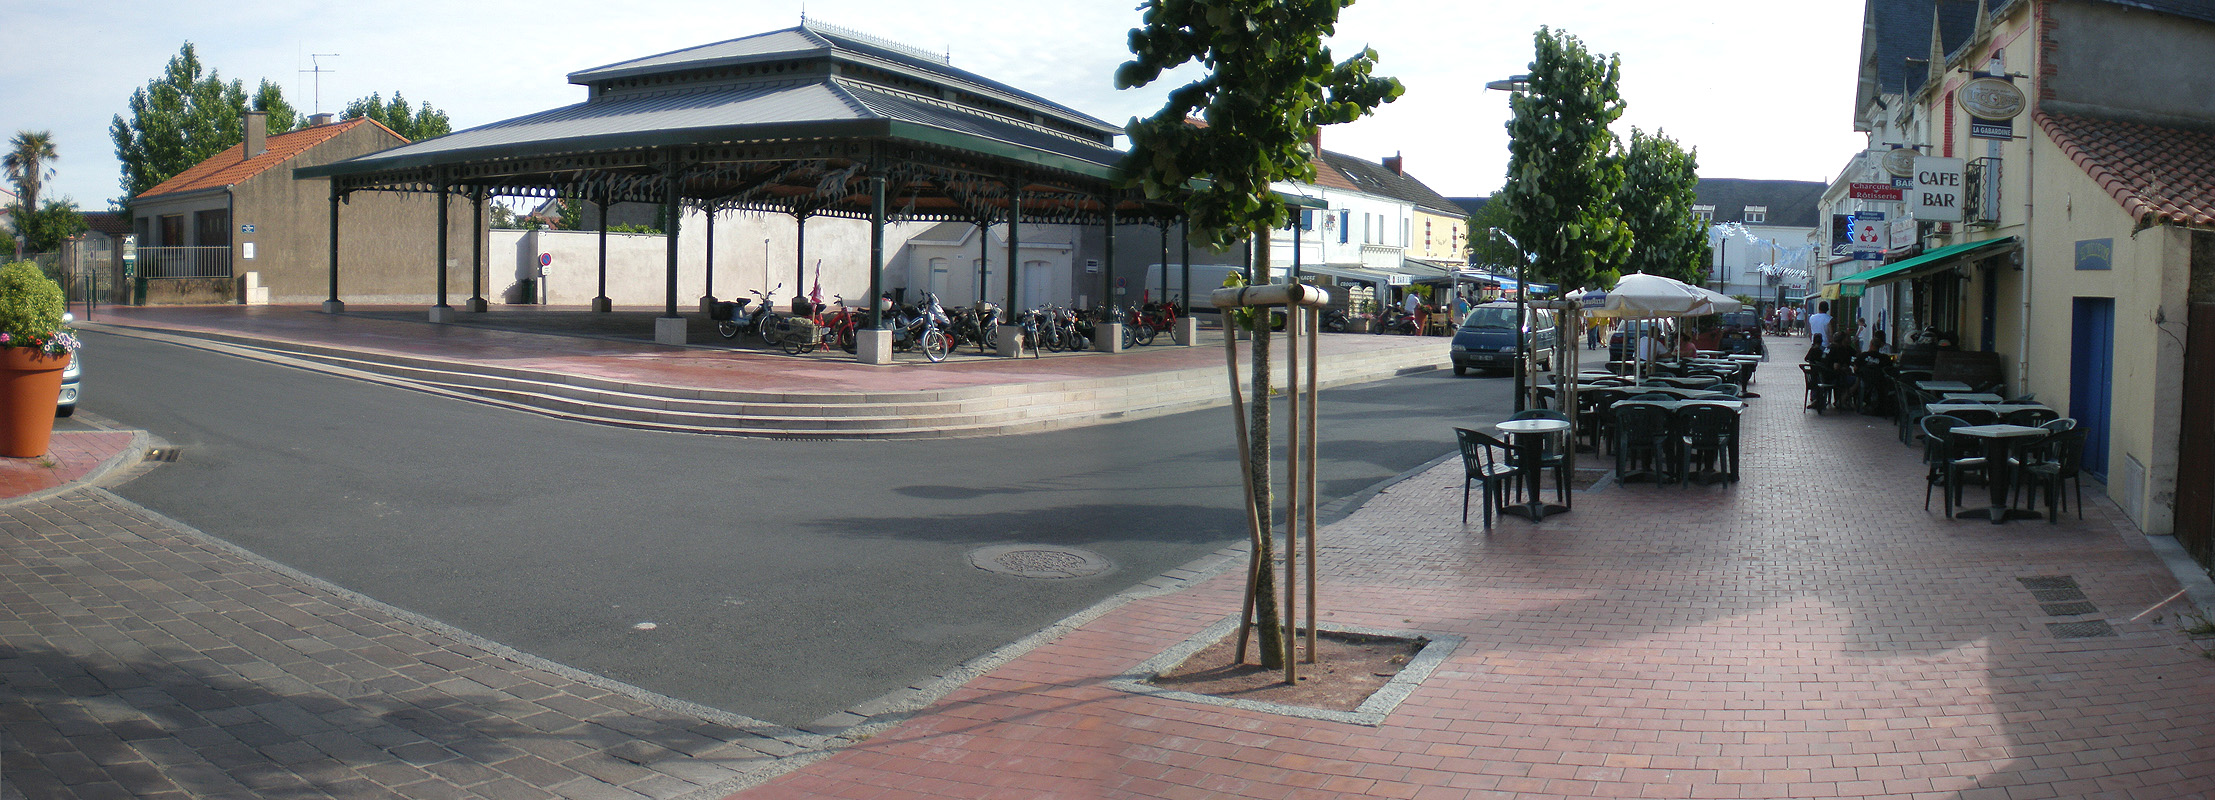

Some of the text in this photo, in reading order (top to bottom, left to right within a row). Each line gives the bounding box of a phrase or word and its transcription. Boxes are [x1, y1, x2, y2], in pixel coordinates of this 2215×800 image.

[1980, 127, 2011, 136] GABARDINE
[1919, 171, 1960, 186] CAFE
[1852, 182, 1895, 190] Charcute
[1896, 179, 1914, 187] BAR
[1856, 191, 1897, 199] Rôtisserie
[1922, 192, 1955, 208] BAR
